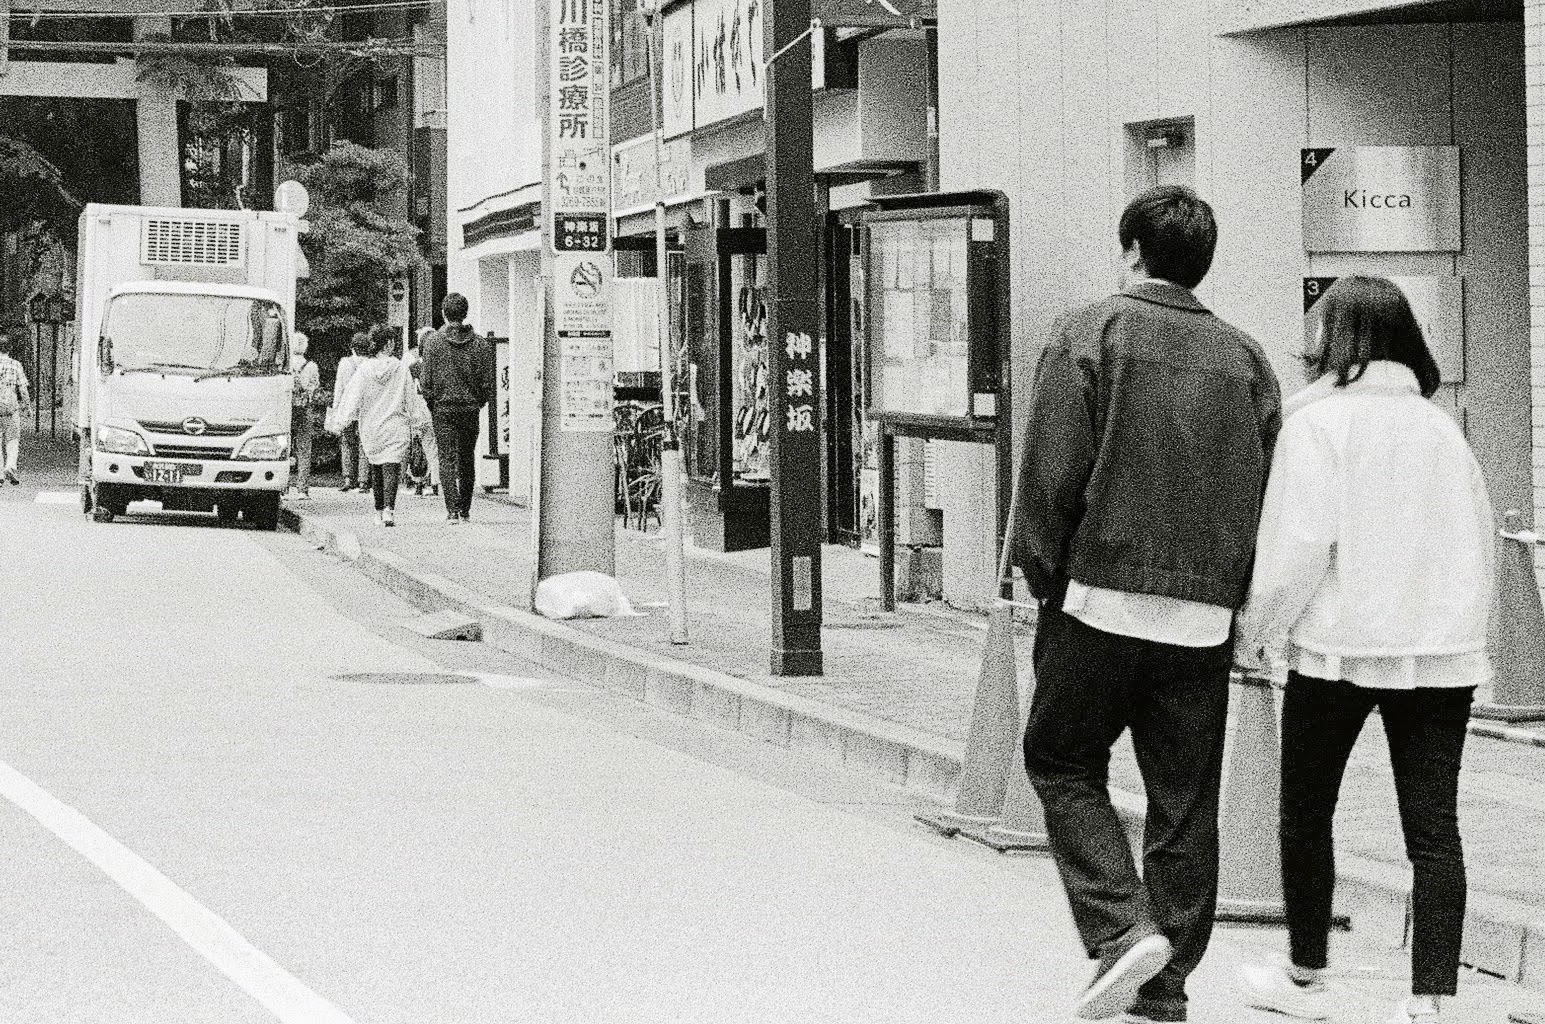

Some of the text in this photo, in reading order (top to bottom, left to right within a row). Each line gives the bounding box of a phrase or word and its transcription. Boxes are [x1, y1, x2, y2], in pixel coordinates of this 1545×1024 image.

[1304, 153, 1318, 167] 4
[1344, 189, 1412, 209] Kicca
[564, 235, 599, 248] 6-32
[1307, 281, 1320, 295] 3
[785, 331, 815, 432] 神楽坂
